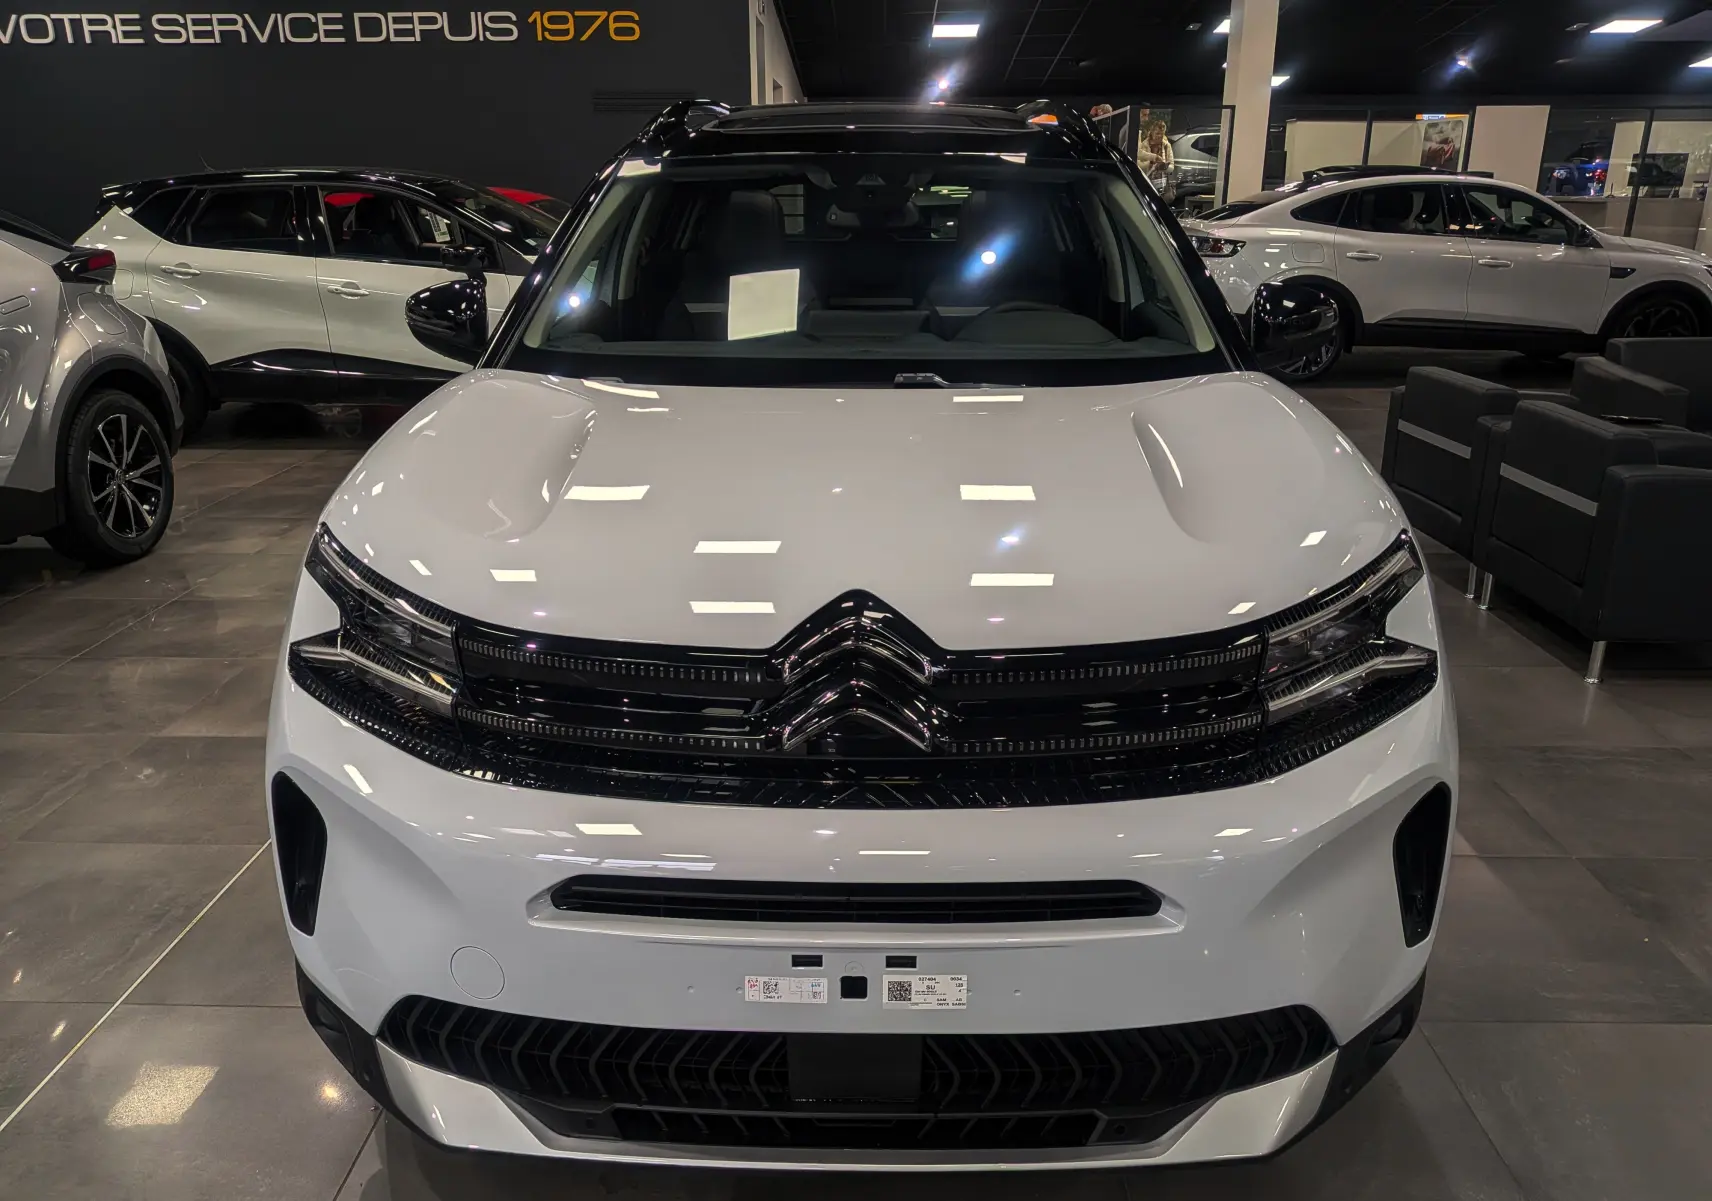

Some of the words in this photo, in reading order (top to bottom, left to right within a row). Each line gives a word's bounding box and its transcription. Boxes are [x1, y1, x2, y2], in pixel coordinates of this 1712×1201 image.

[151, 12, 346, 44] SERVICE
[353, 11, 519, 42] DEPUIS
[527, 10, 641, 42] 1976
